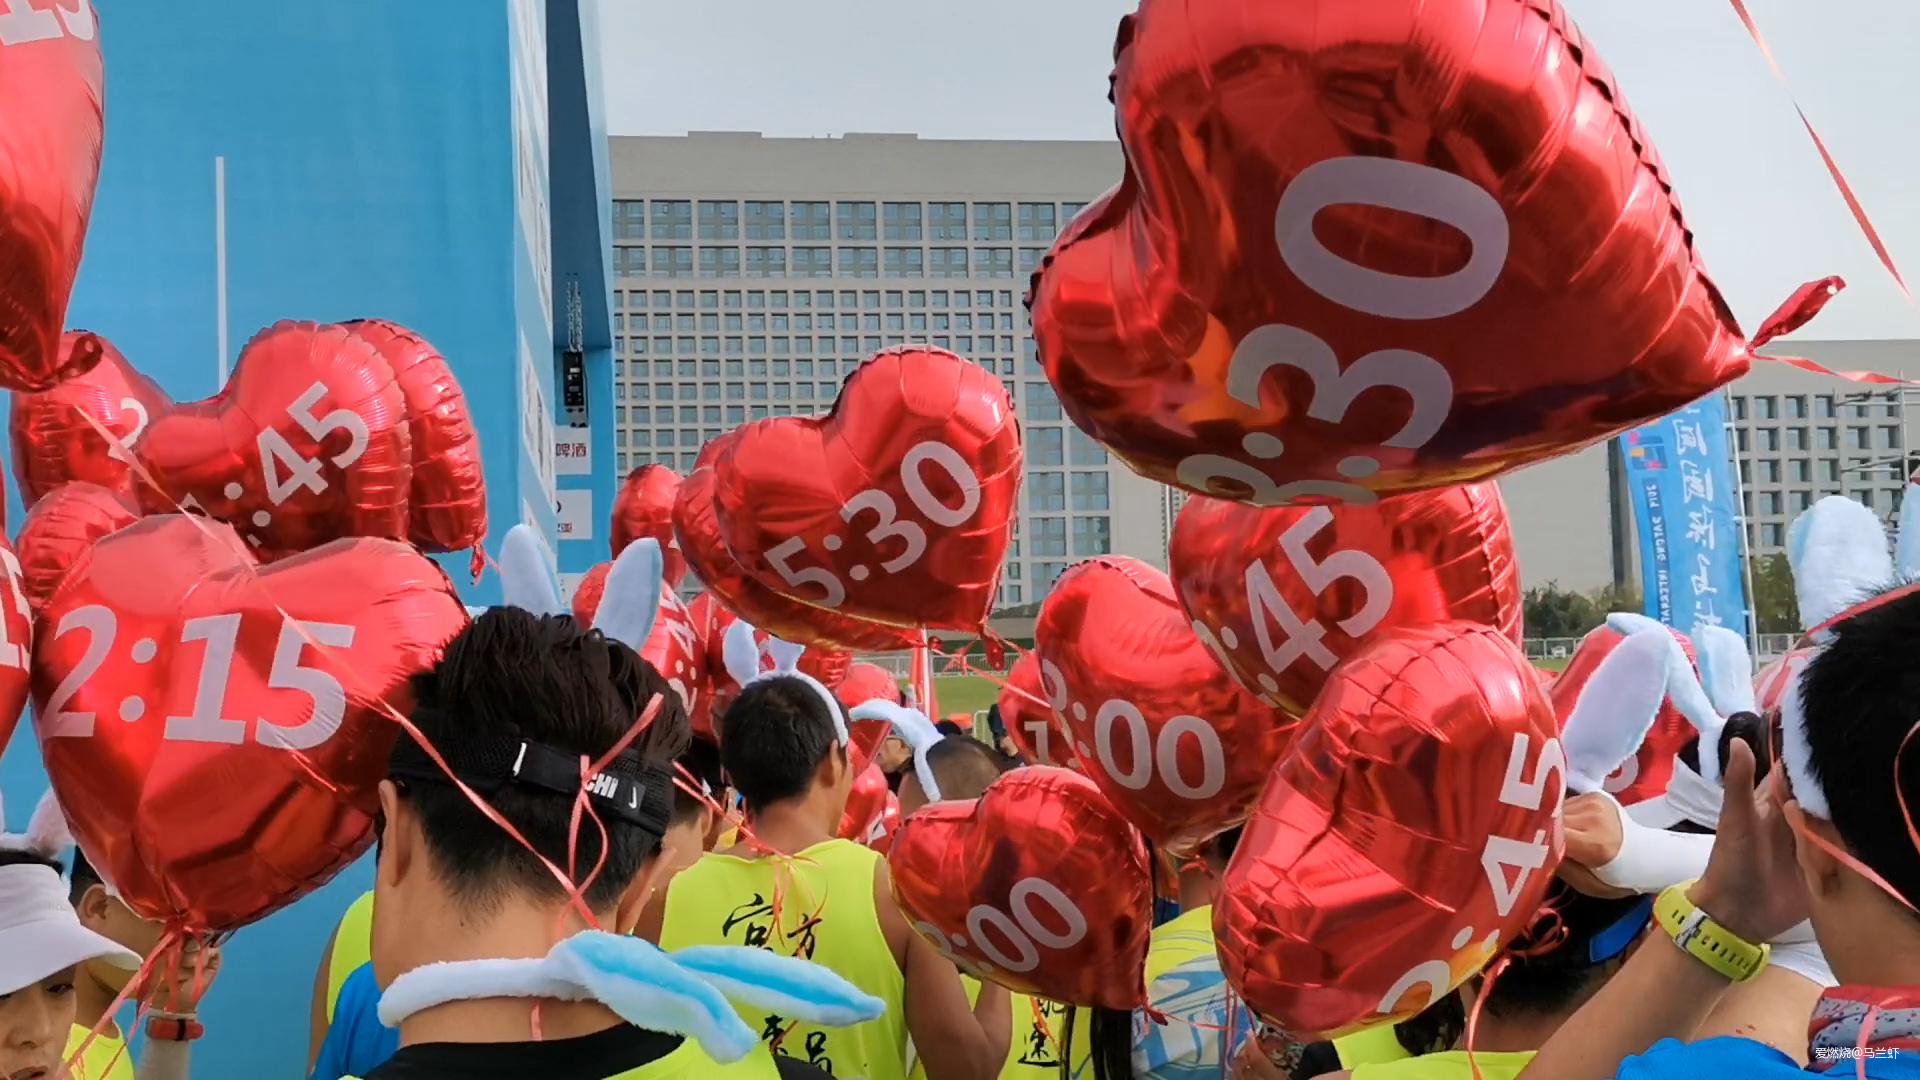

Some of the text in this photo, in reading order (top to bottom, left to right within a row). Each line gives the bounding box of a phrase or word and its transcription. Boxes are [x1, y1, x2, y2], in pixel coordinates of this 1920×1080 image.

[183, 381, 369, 548] :45
[764, 441, 980, 608] 5:30
[40, 604, 356, 750] 2:15
[1192, 505, 1393, 708] :45
